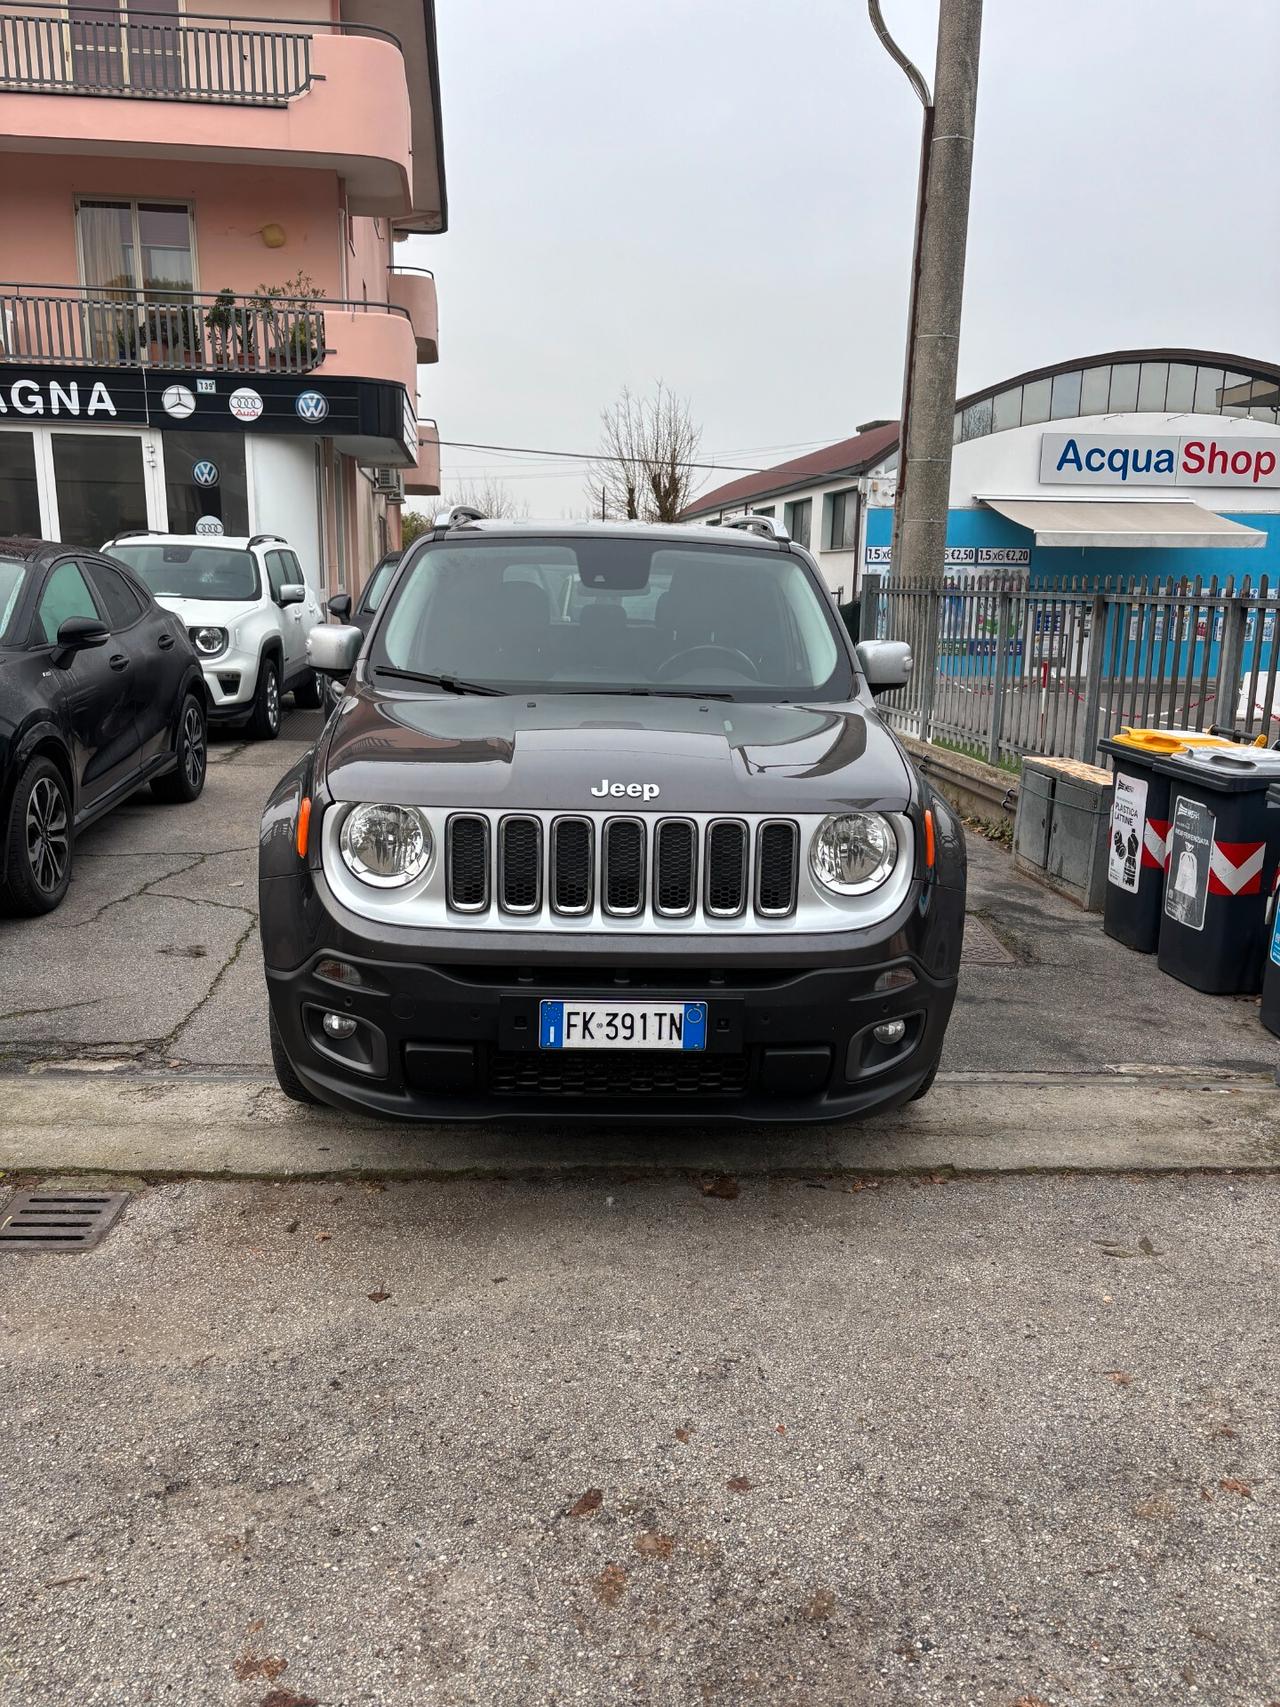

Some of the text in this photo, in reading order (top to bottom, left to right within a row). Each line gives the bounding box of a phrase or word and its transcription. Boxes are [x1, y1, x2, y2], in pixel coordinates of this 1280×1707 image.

[0, 379, 117, 416] GNA
[235, 409, 259, 417] Audi
[1056, 439, 1276, 483] Acqua Shop
[868, 548, 880, 560] 1,5
[951, 548, 974, 562] €2,50
[979, 549, 1029, 562] 1,5 x6 €2,20
[591, 779, 660, 801] Jeep
[1115, 801, 1139, 818] PLASTICA
